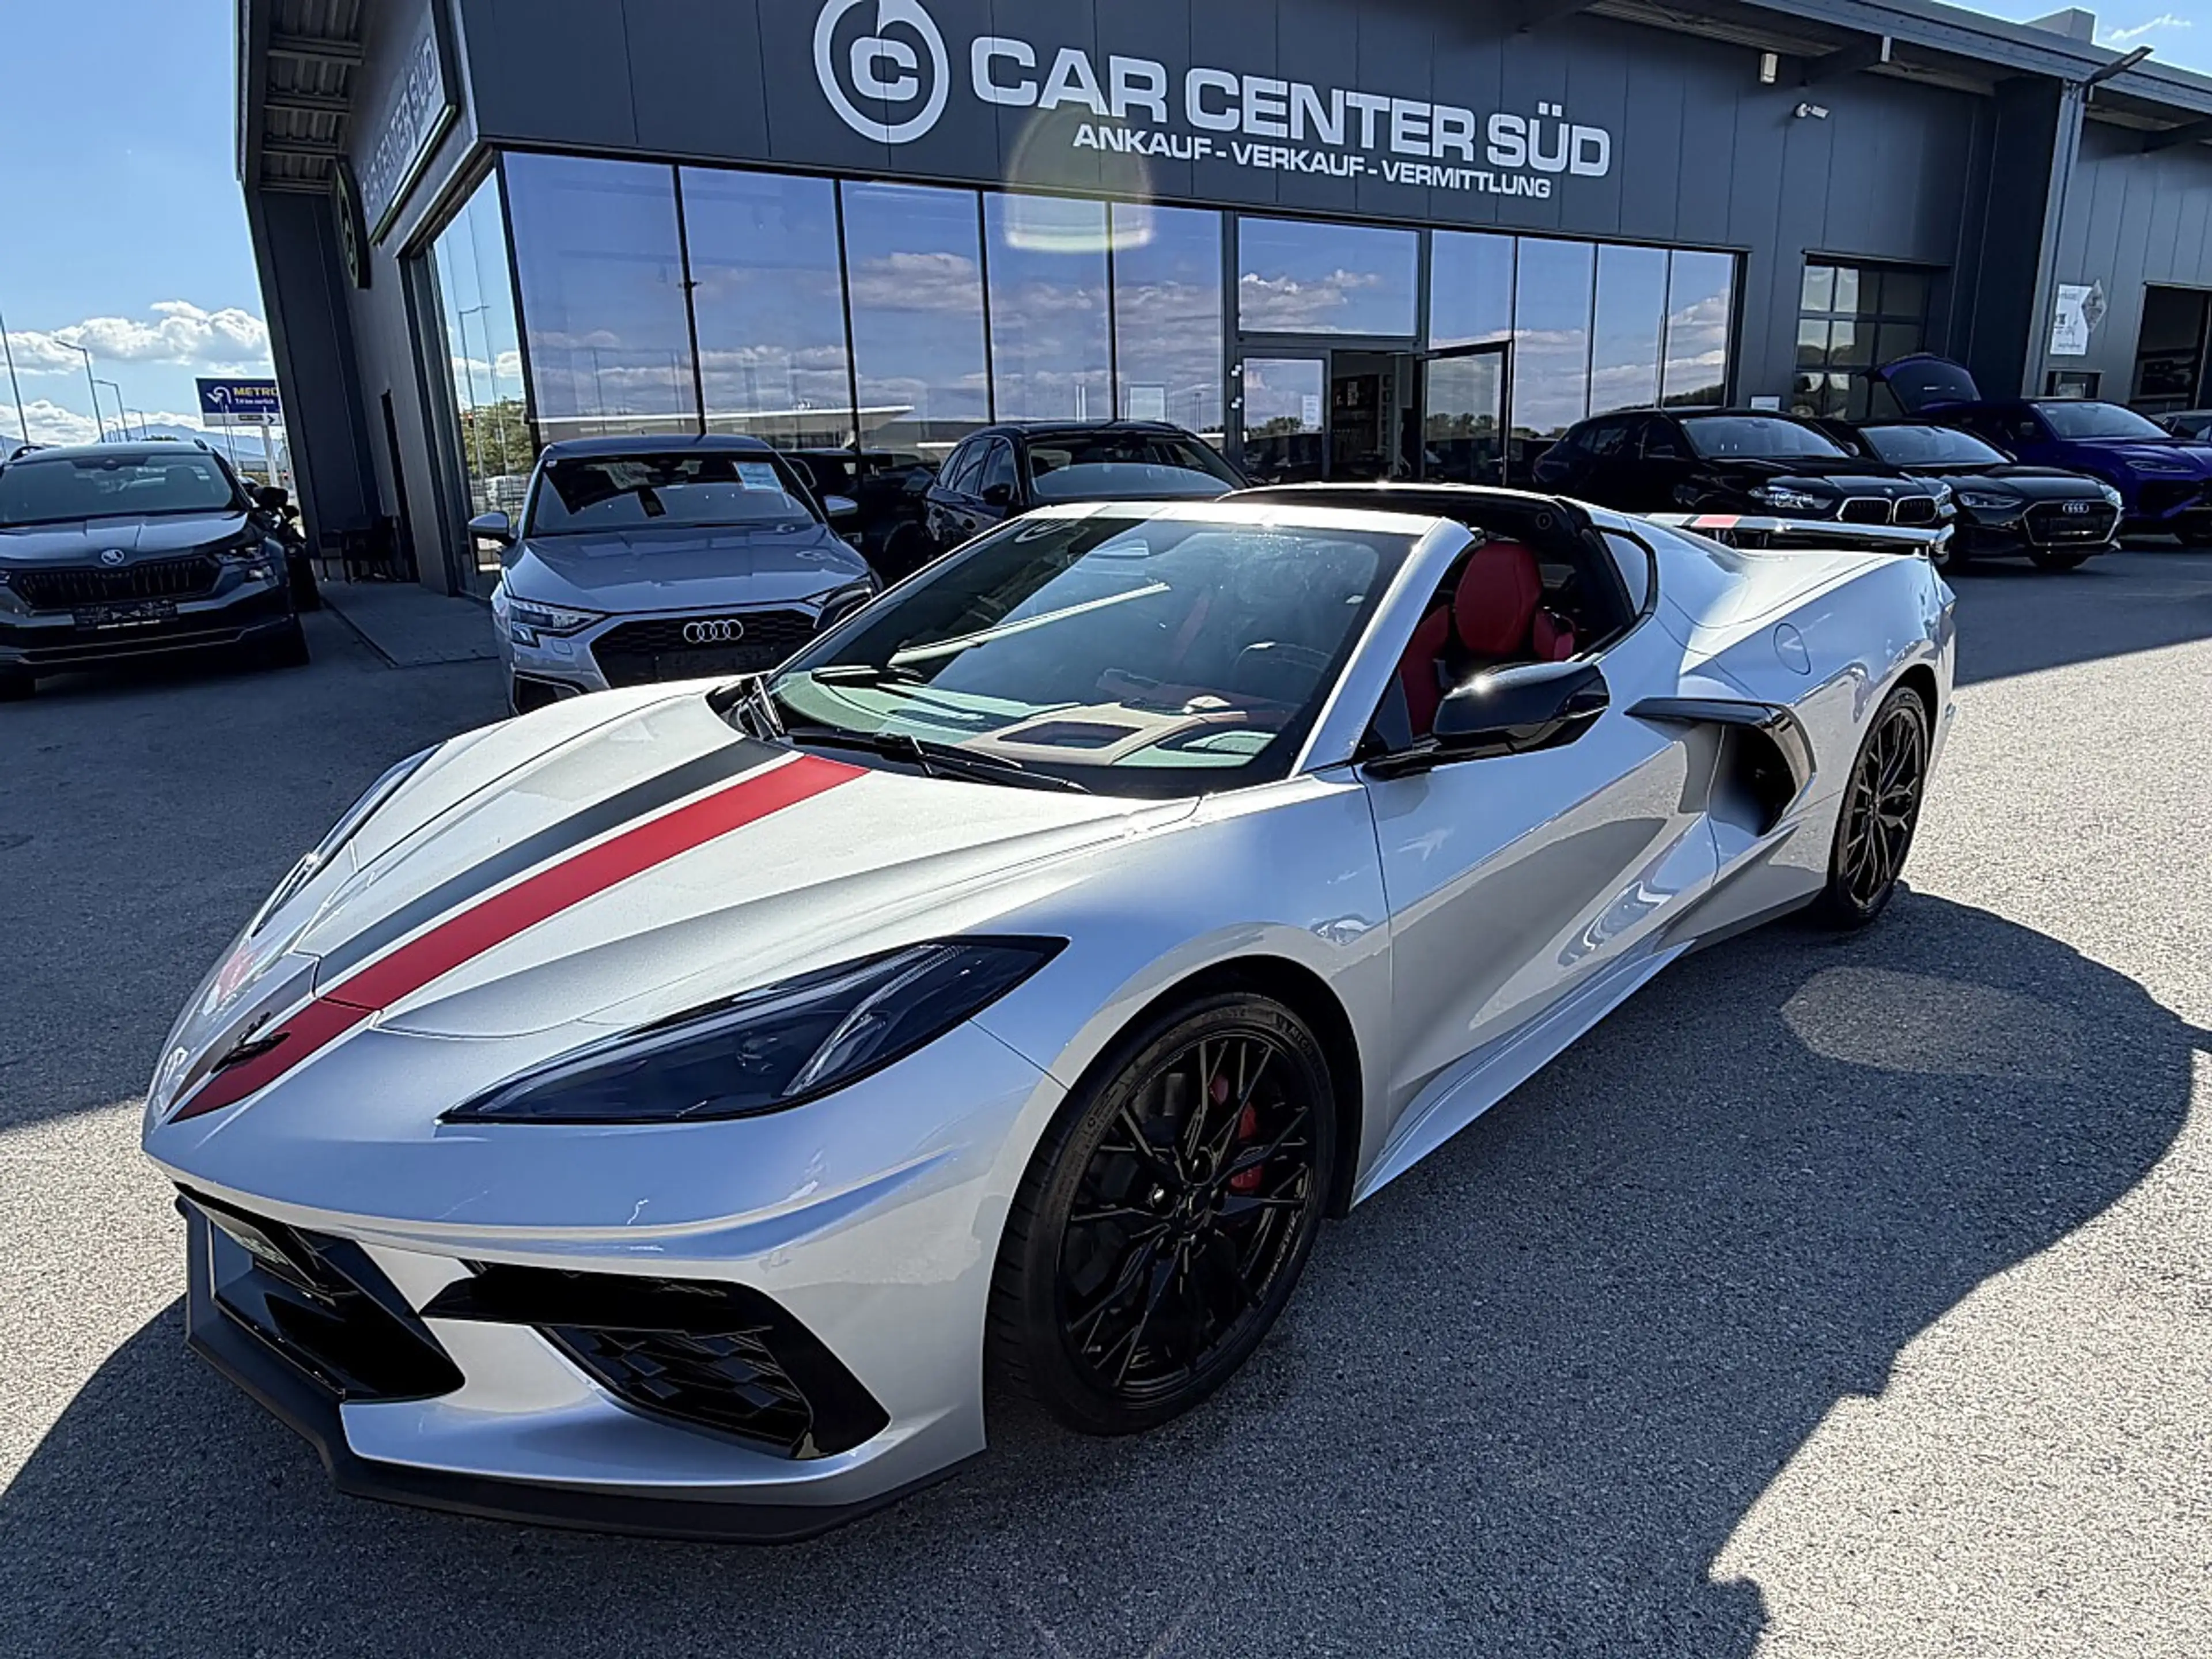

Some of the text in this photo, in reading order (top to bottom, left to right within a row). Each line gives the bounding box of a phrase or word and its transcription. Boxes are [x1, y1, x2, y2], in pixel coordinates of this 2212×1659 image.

[971, 36, 1611, 177] CAR CENTER SÜD
[233, 387, 277, 397] METRO
